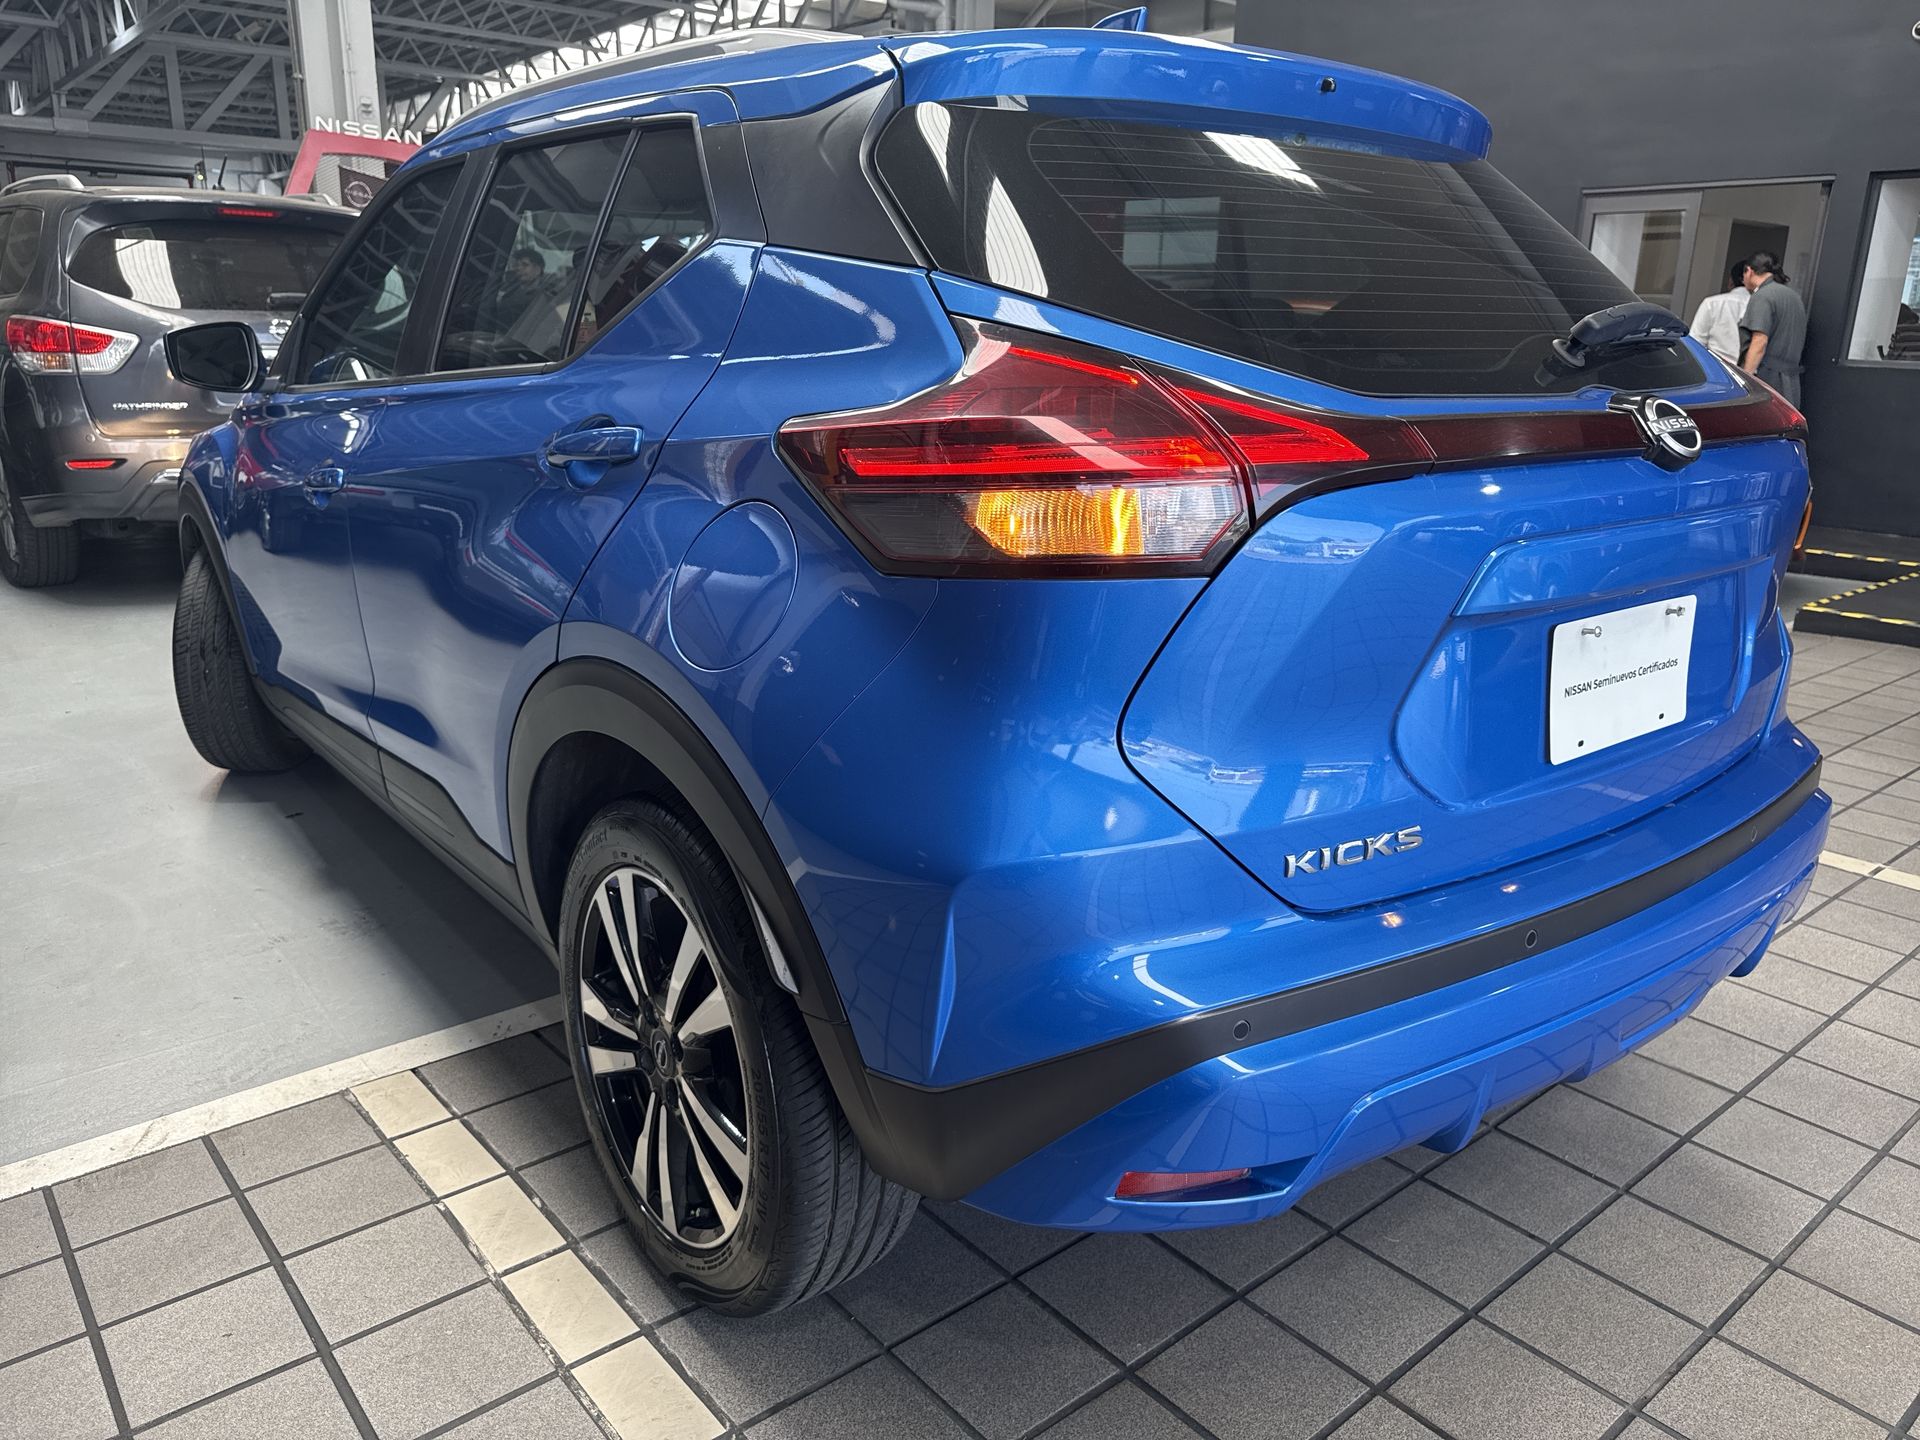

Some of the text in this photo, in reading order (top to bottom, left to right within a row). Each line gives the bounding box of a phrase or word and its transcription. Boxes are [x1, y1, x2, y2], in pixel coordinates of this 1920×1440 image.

[315, 115, 423, 147] NISSAN
[1564, 658, 1679, 698] NISSAN Seminuevos Certificados
[1284, 824, 1424, 879] KICKS
